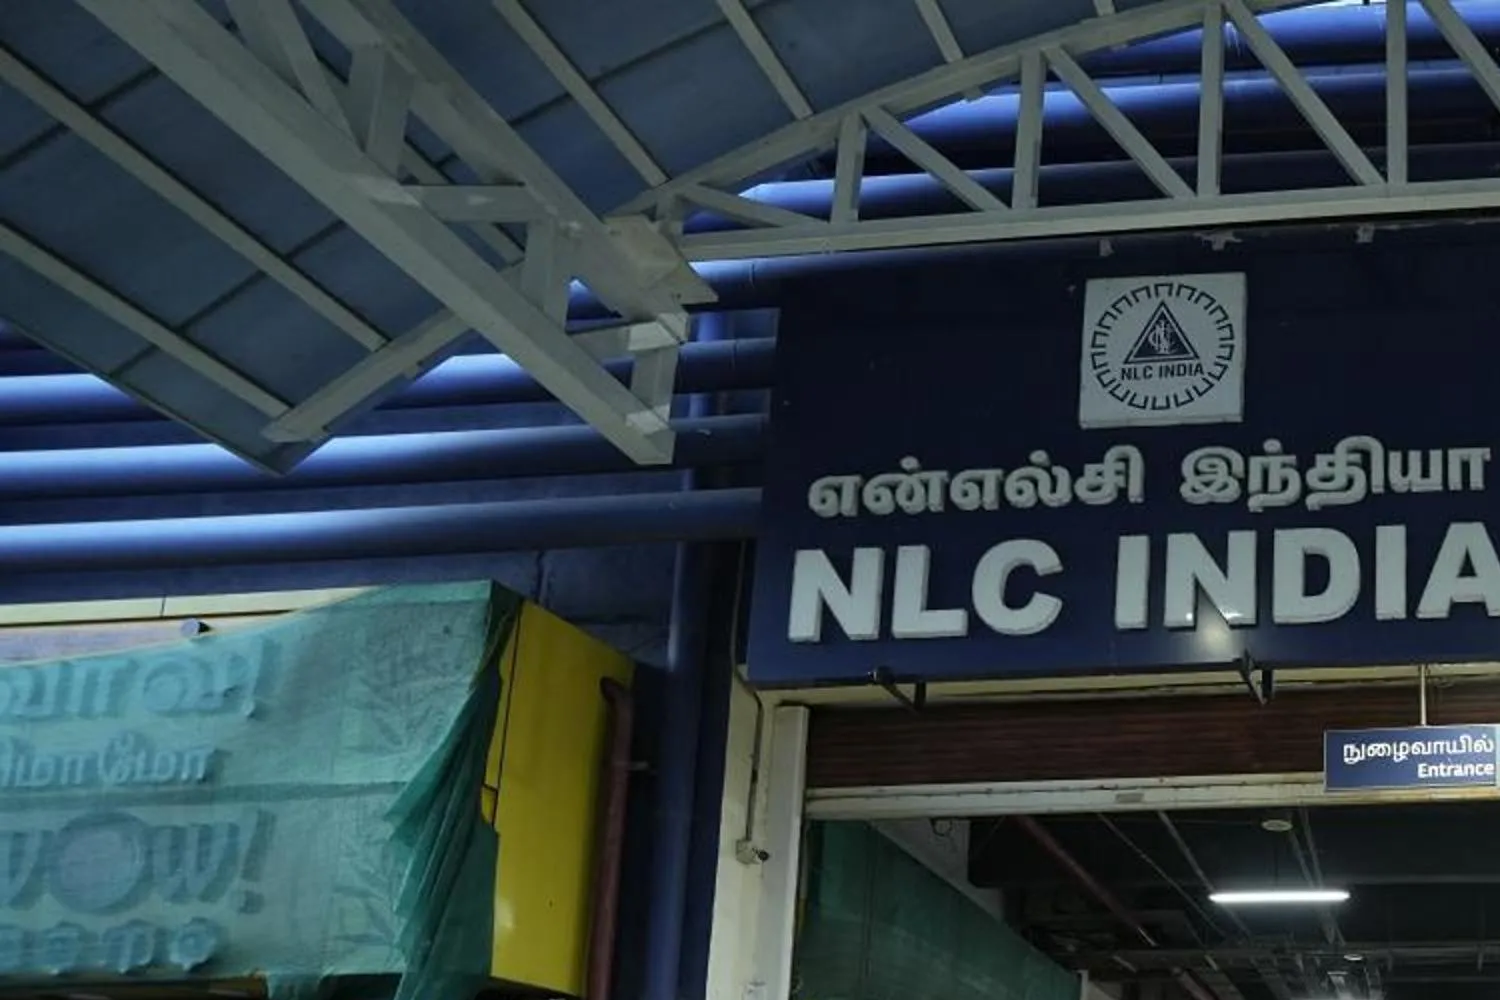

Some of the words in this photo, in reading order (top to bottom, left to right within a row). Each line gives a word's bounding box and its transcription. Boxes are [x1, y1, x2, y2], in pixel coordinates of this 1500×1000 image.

[1121, 365, 1153, 380] NLC
[1158, 363, 1204, 378] INDIA
[808, 445, 1144, 517] என்எல்சி
[1180, 435, 1490, 512] இந்தியா
[787, 538, 1063, 642] NLC
[1343, 733, 1495, 765] நுழைவாயில்
[1417, 762, 1495, 779] Entrance
